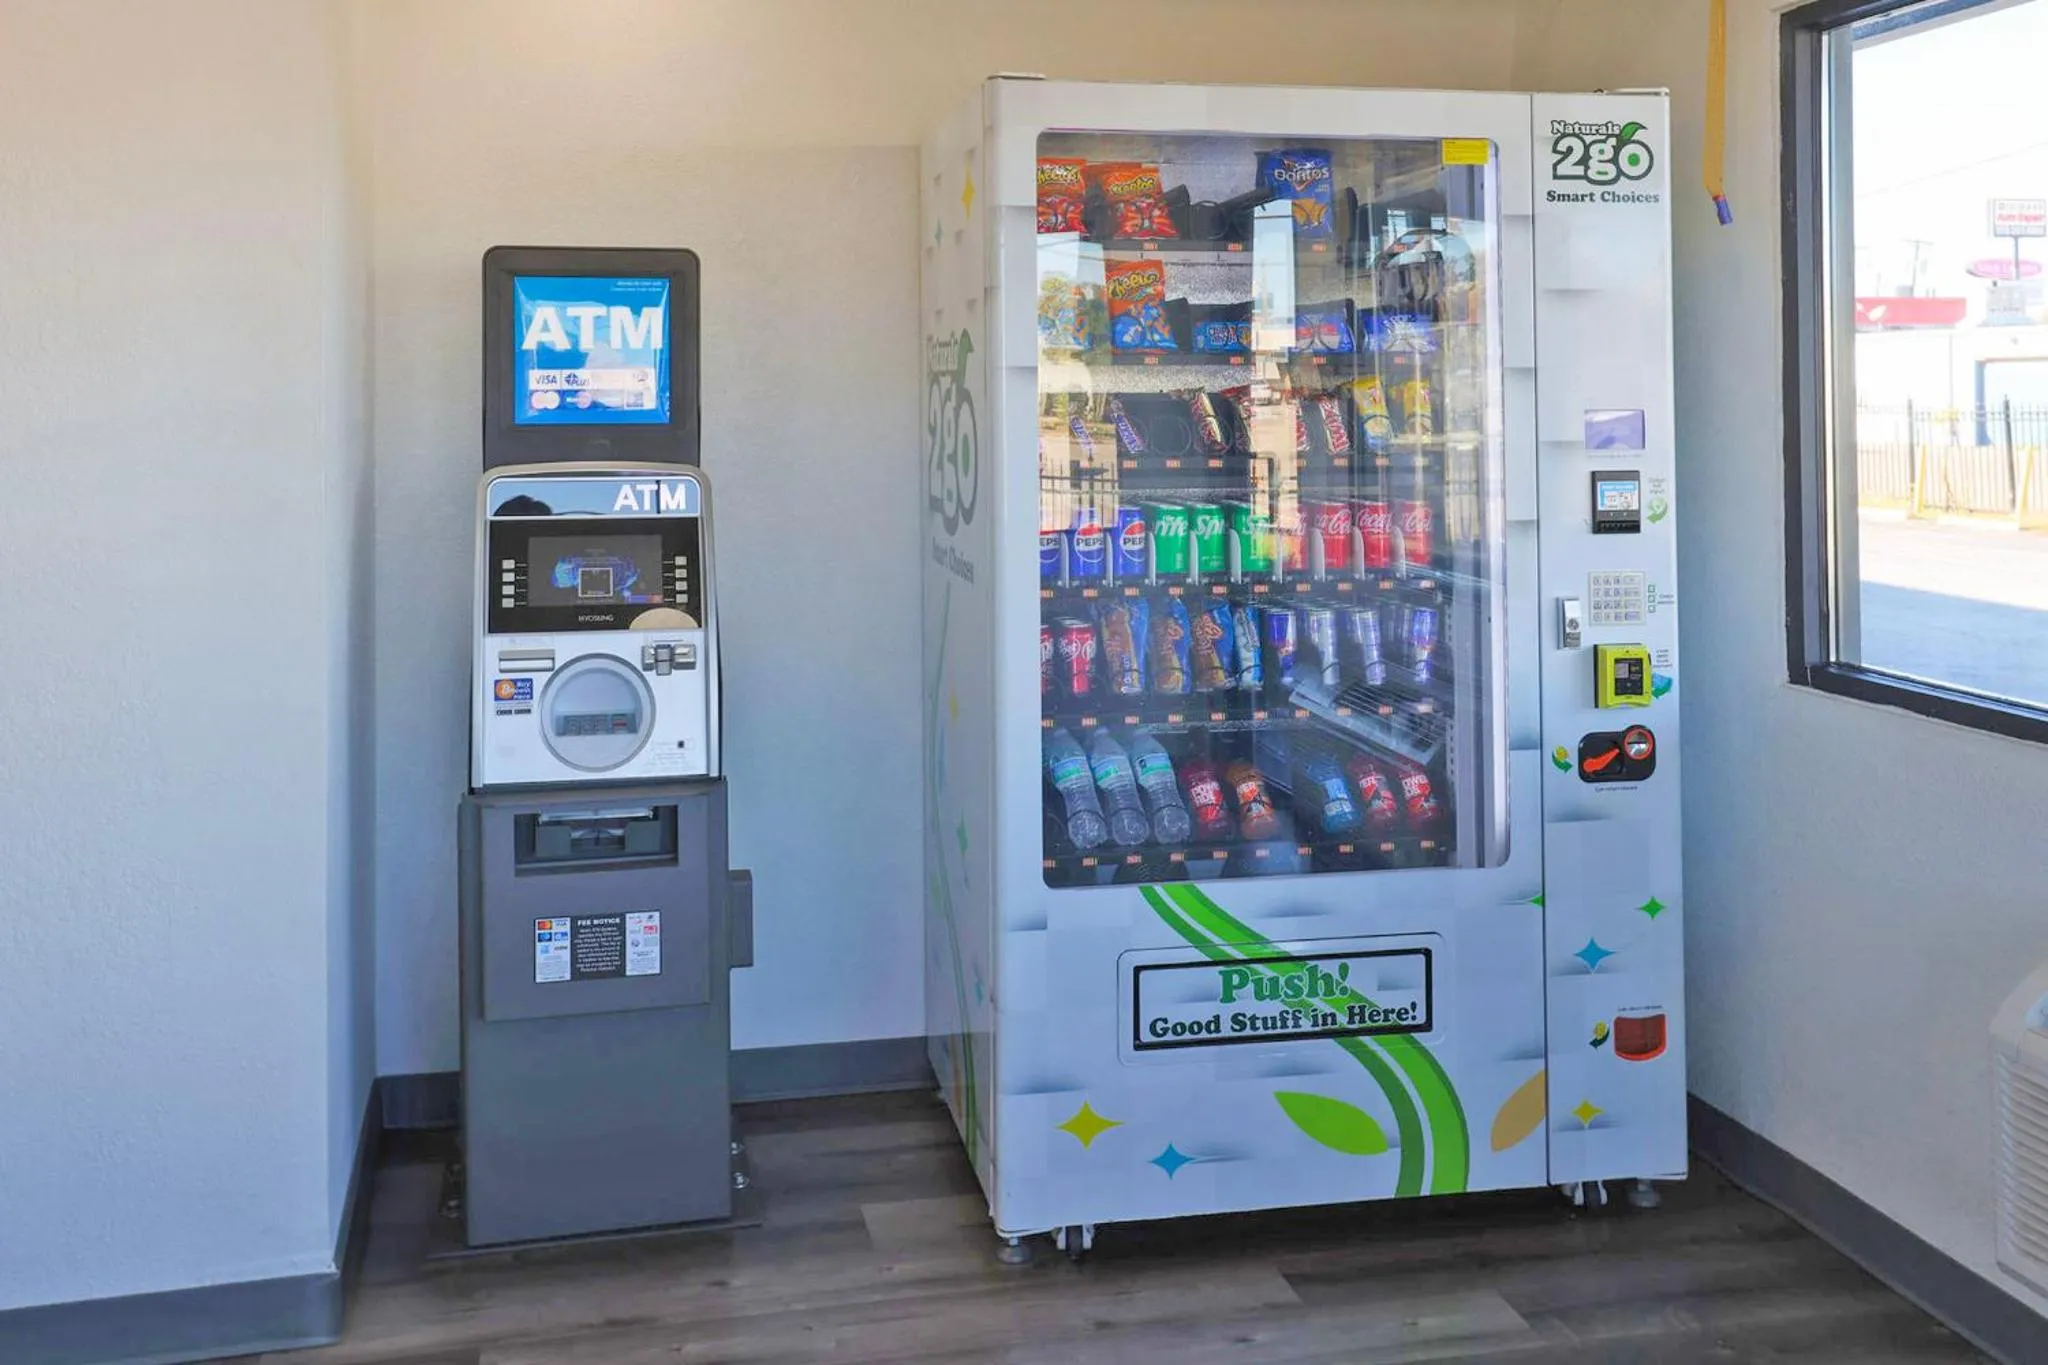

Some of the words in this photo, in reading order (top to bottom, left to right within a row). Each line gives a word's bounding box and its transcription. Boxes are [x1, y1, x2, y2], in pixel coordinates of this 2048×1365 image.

[1551, 120, 1621, 135] Naturals
[1273, 166, 1331, 182] Doritos
[1546, 190, 1596, 202] Smart
[1600, 190, 1660, 203] Choices
[521, 305, 663, 352] ATM
[535, 374, 558, 385] VISA
[613, 483, 687, 512] ATM
[593, 917, 621, 925] NOTICE
[1219, 961, 1351, 1004] Push!
[1149, 1014, 1221, 1038] Good
[1230, 1008, 1302, 1031] Stuff
[1311, 1008, 1338, 1028] in
[1346, 1001, 1418, 1028] Here!
